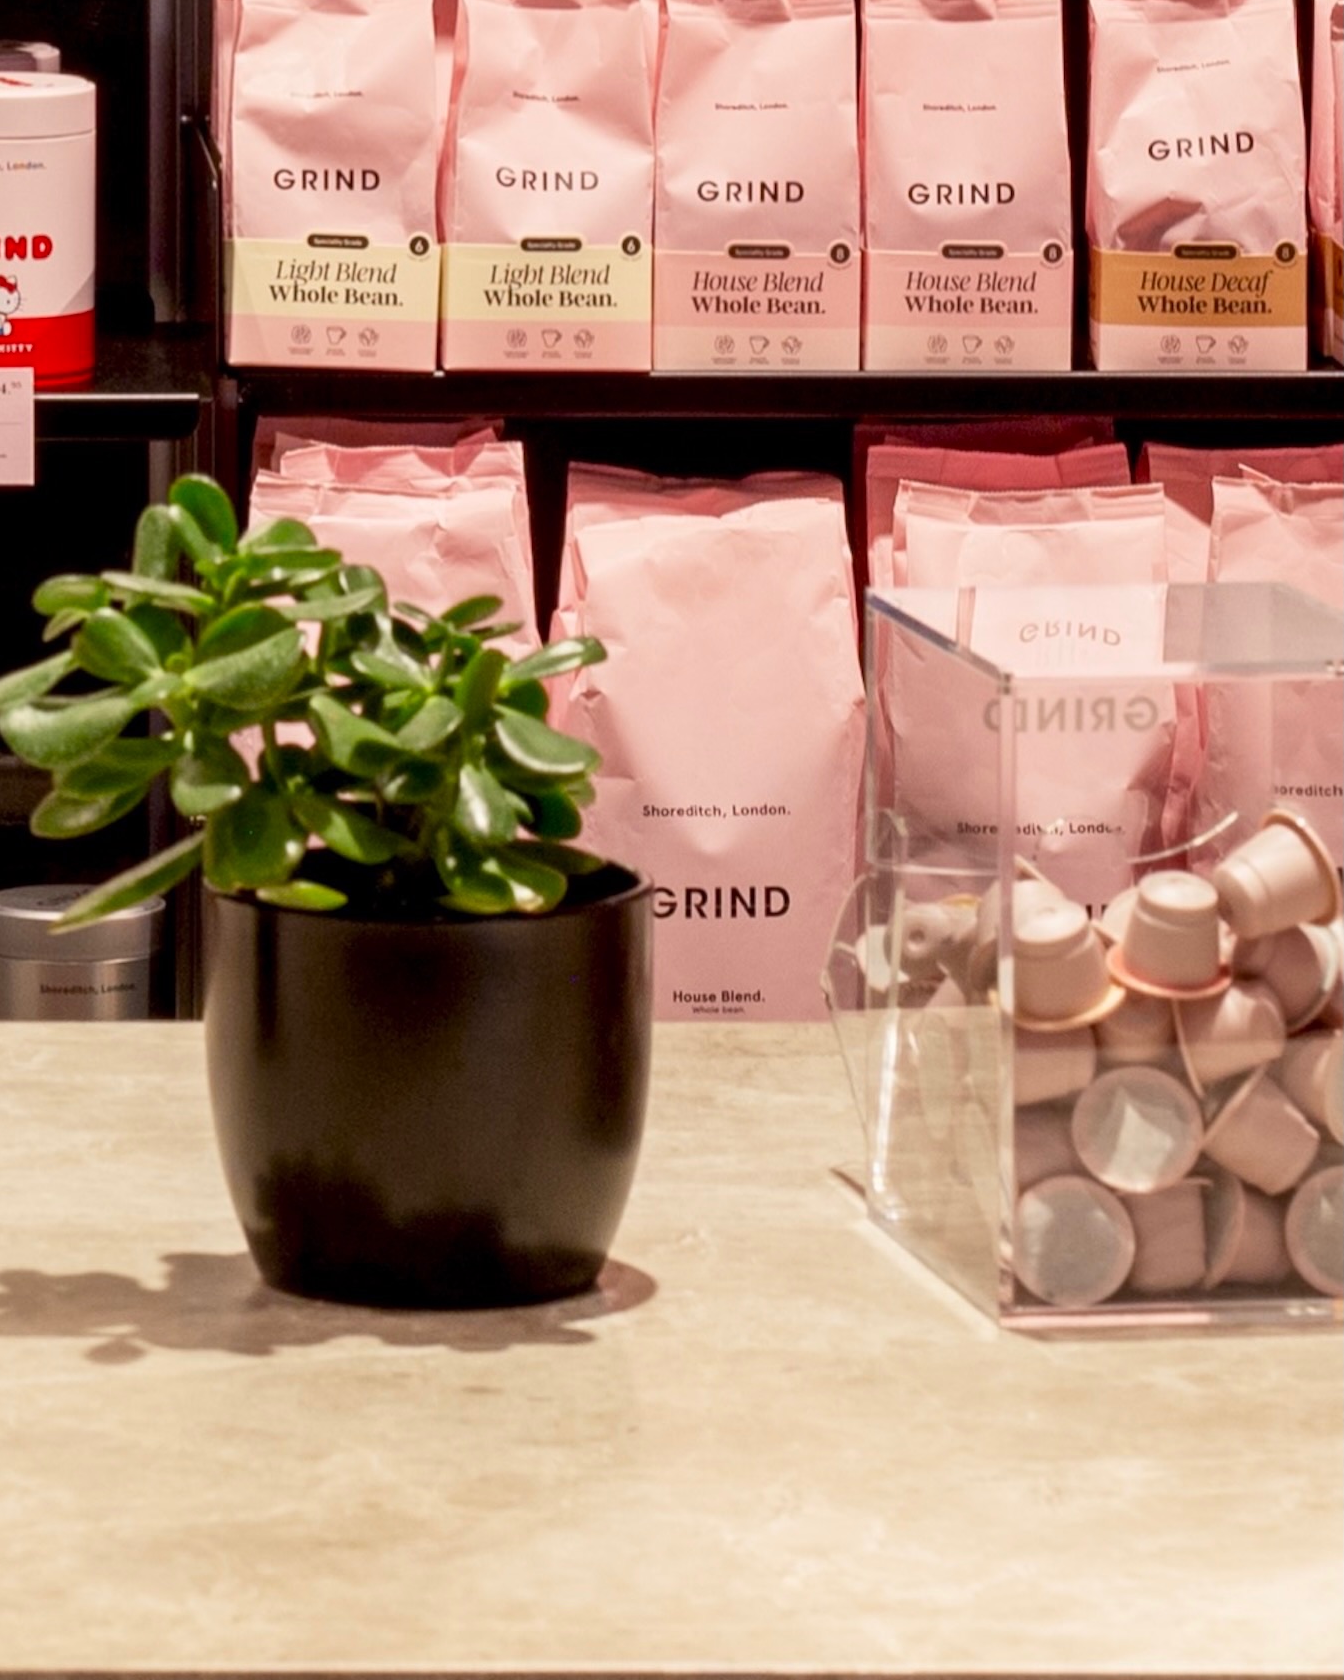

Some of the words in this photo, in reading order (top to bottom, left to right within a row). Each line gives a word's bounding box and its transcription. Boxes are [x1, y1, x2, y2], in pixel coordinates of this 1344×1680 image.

[697, 180, 805, 204] GRIND
[693, 270, 758, 293] House
[762, 271, 824, 293] Blend
[691, 295, 761, 314] Whole
[766, 295, 826, 315] Bean.
[640, 803, 727, 819] Shoreditch,
[732, 803, 791, 817] London.
[653, 886, 790, 919] GRIND
[672, 990, 717, 1003] House
[722, 991, 765, 1003] Blend.
